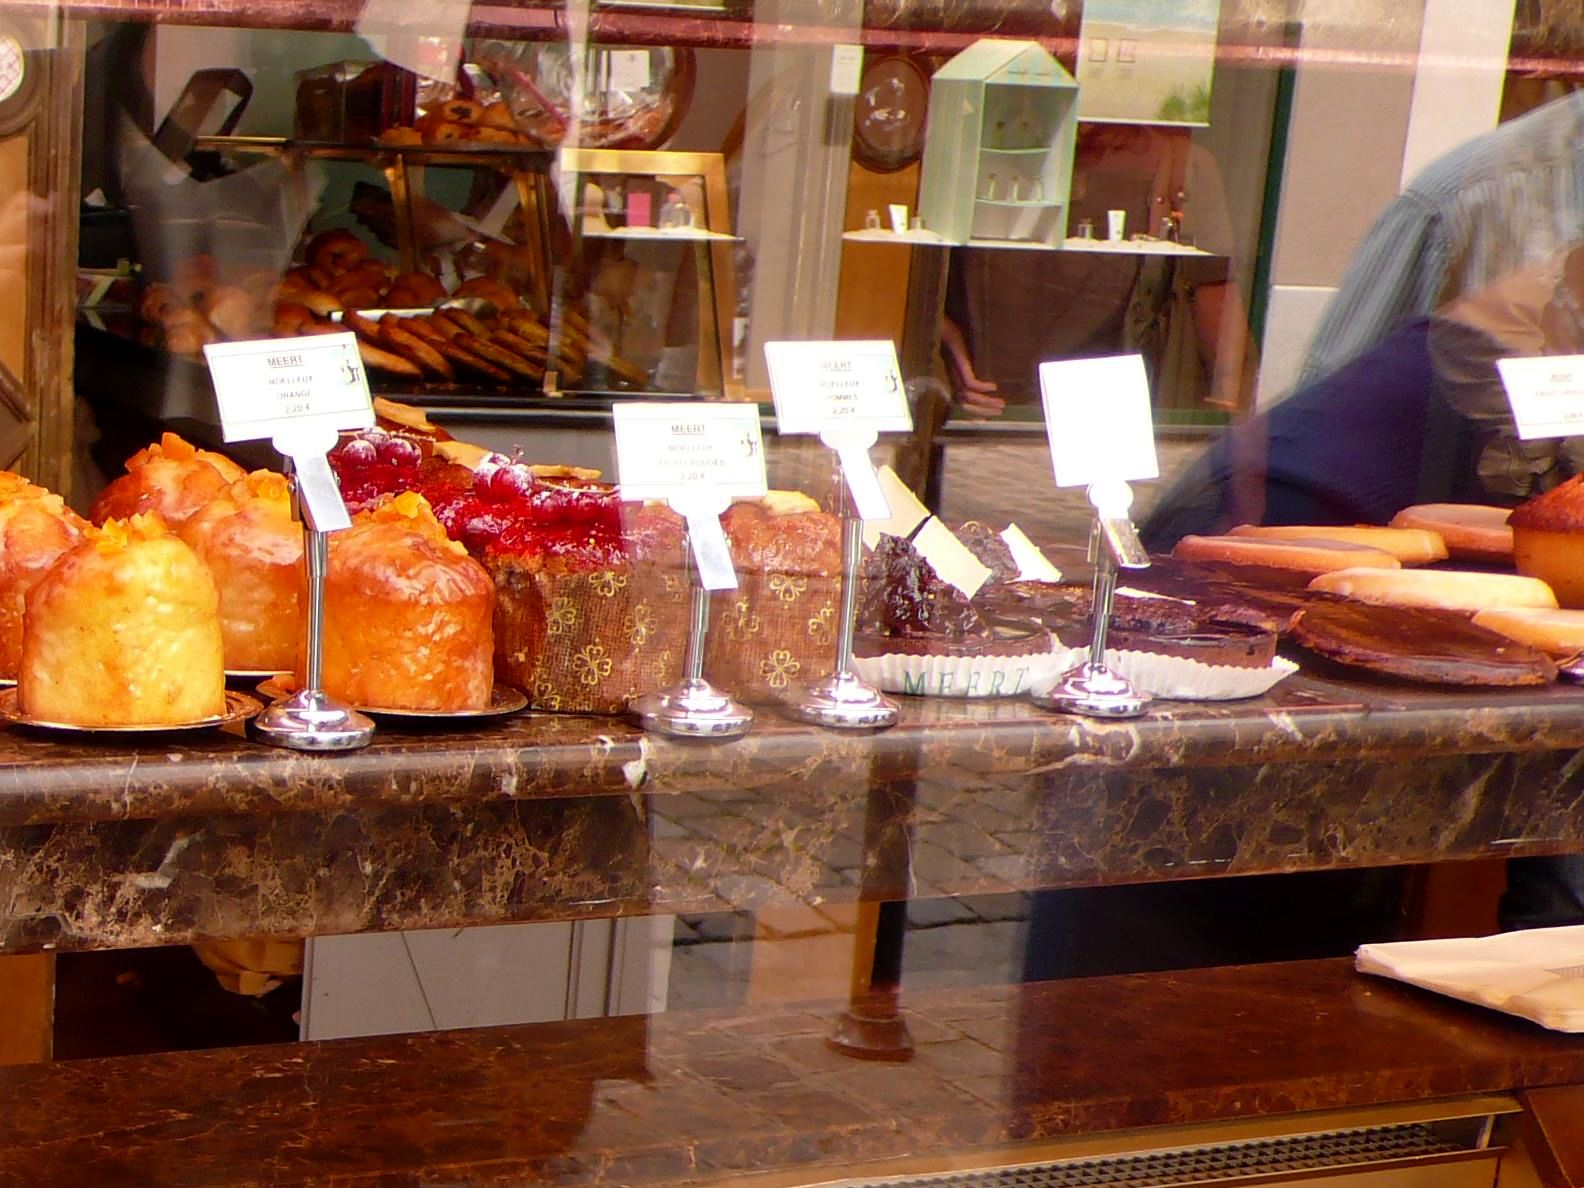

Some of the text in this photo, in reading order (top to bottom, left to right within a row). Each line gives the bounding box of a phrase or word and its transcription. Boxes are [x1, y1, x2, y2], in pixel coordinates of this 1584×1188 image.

[267, 354, 304, 367] MEERT
[671, 424, 706, 433] MEERT
[904, 667, 1030, 696] MEERT
